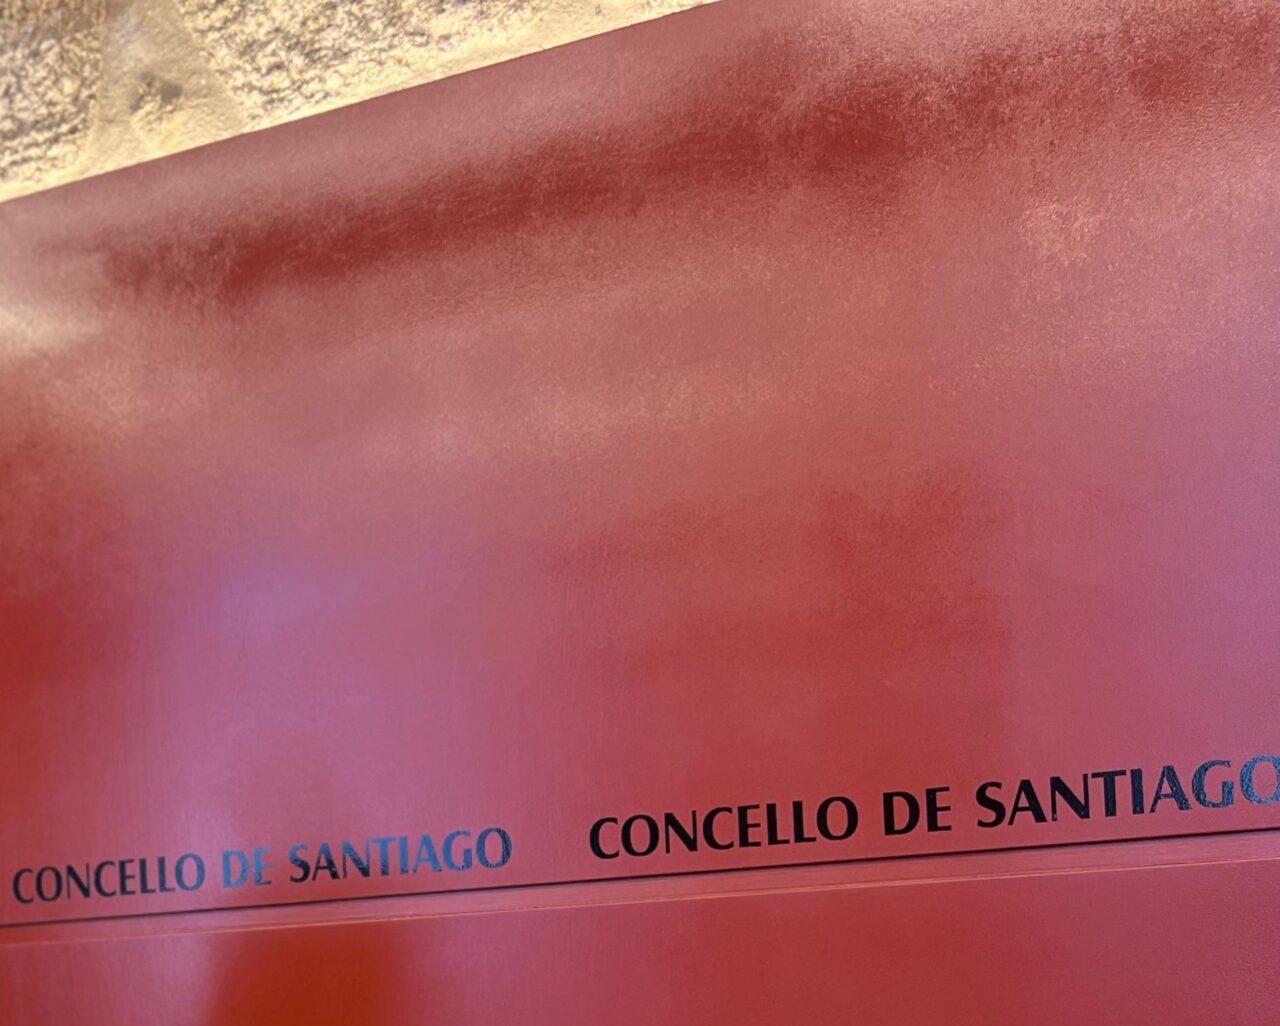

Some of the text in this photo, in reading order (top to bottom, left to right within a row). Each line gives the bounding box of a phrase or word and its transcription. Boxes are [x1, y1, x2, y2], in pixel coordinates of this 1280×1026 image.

[589, 754, 1280, 860] CONCELLO DE SANTIAGO
[12, 826, 513, 905] CONCELLO DE SANTIAGO
